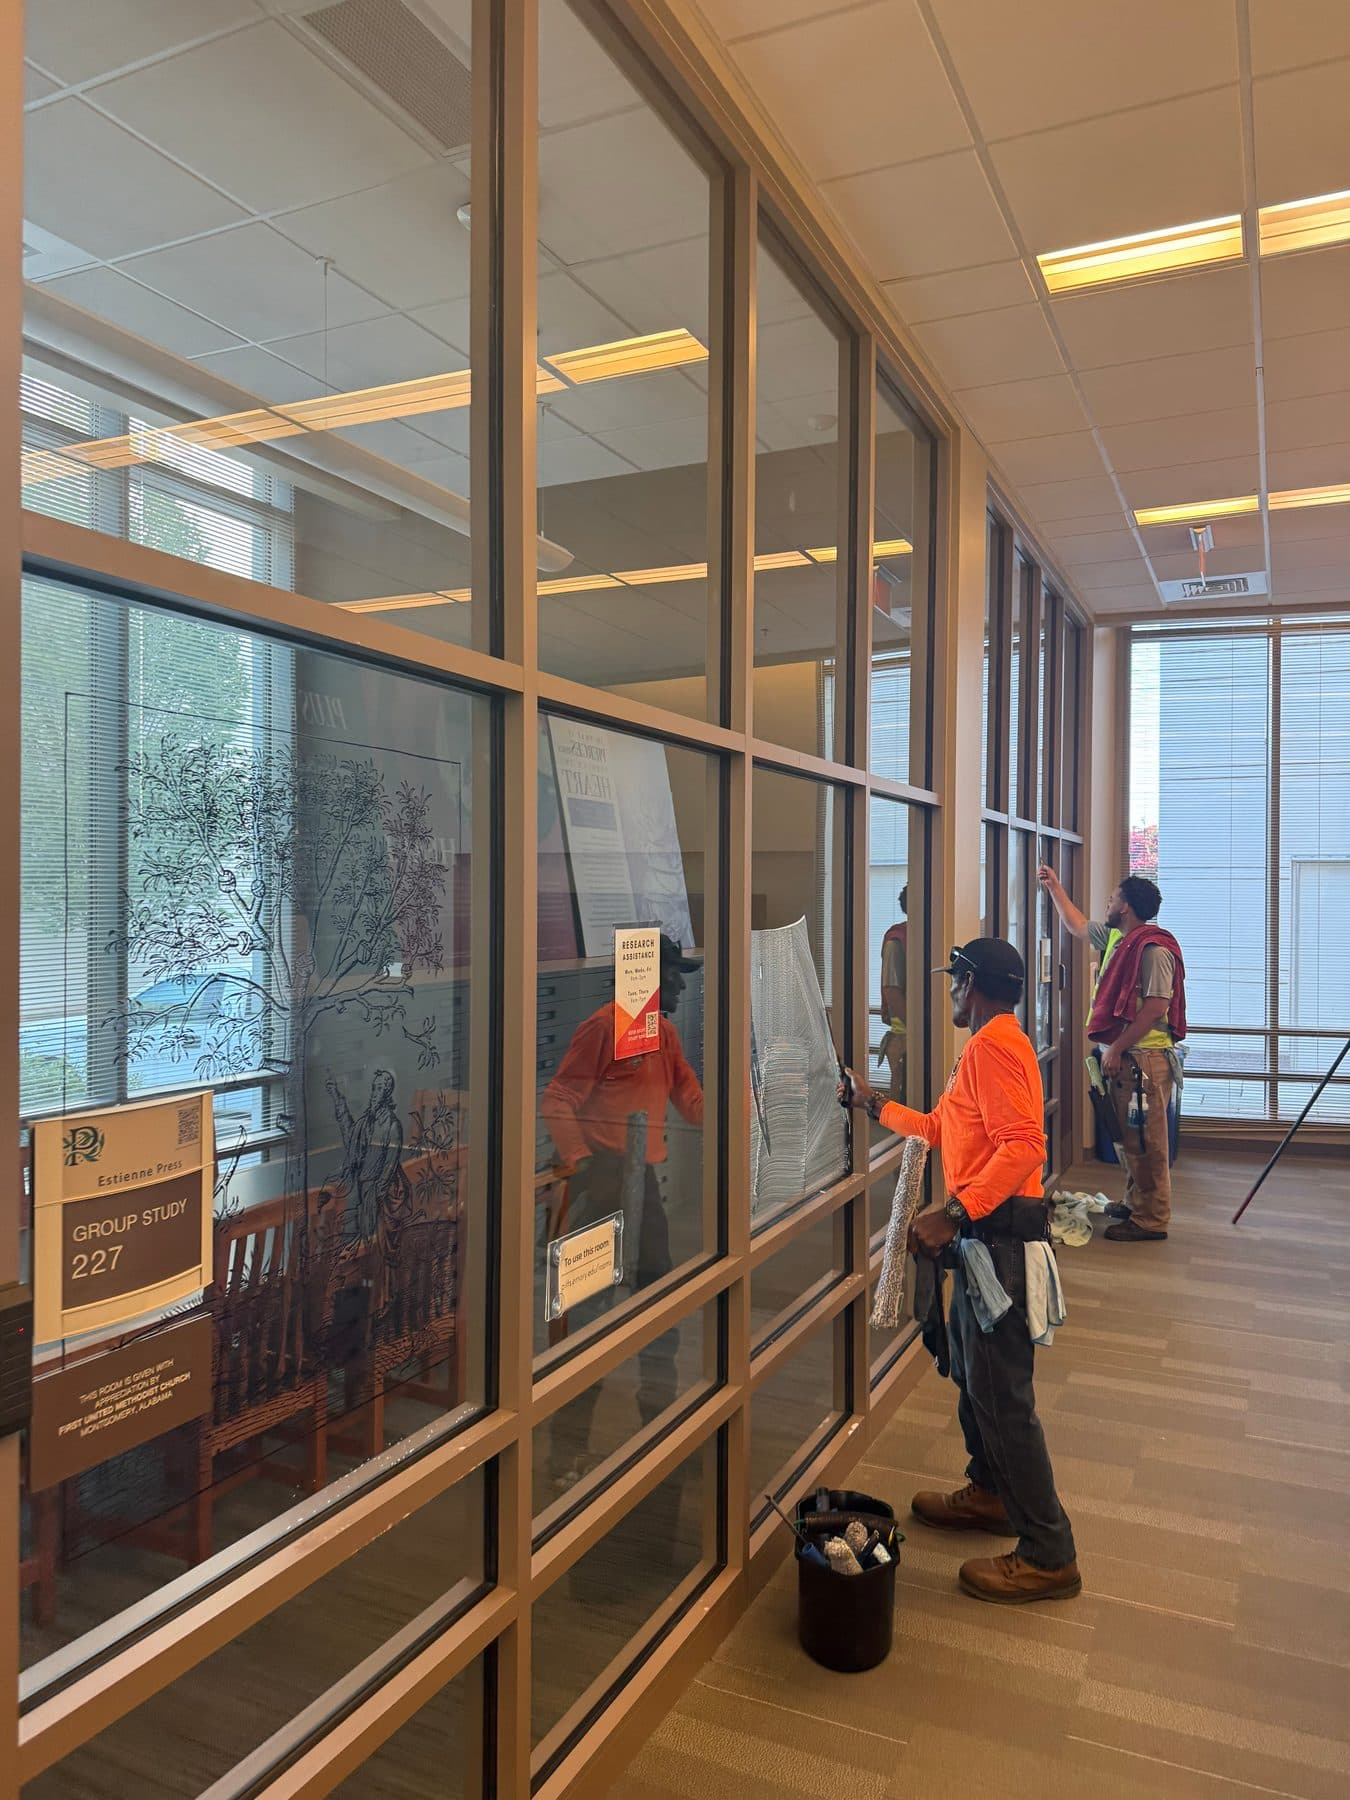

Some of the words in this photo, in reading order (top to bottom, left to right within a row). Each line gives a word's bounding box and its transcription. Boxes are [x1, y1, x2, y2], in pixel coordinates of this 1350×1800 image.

[622, 939, 655, 950] RESEARCH
[622, 951, 654, 961] ASSISTANCE
[97, 1168, 153, 1187] Estienne
[156, 1159, 183, 1176] Press
[72, 1214, 138, 1242] GROUP
[142, 1198, 188, 1226] STUDY
[71, 1244, 124, 1280] 227
[564, 1257, 572, 1268] To
[572, 1253, 582, 1263] use
[583, 1247, 594, 1258] this
[594, 1240, 609, 1253] room
[80, 1390, 98, 1404] THIS
[99, 1380, 123, 1395] ROOM
[124, 1375, 132, 1386] IS
[132, 1367, 155, 1381] GIVEN
[156, 1358, 175, 1373] WITH
[95, 1380, 149, 1409] APPRECIATION
[149, 1374, 160, 1386] BY
[59, 1418, 82, 1436] FIRST
[84, 1405, 114, 1424] UNITED
[115, 1385, 159, 1410] METHODIST
[160, 1371, 191, 1391] CHURCH
[81, 1407, 139, 1437] MONTGOMERY,
[139, 1389, 173, 1411] ALABAMA
